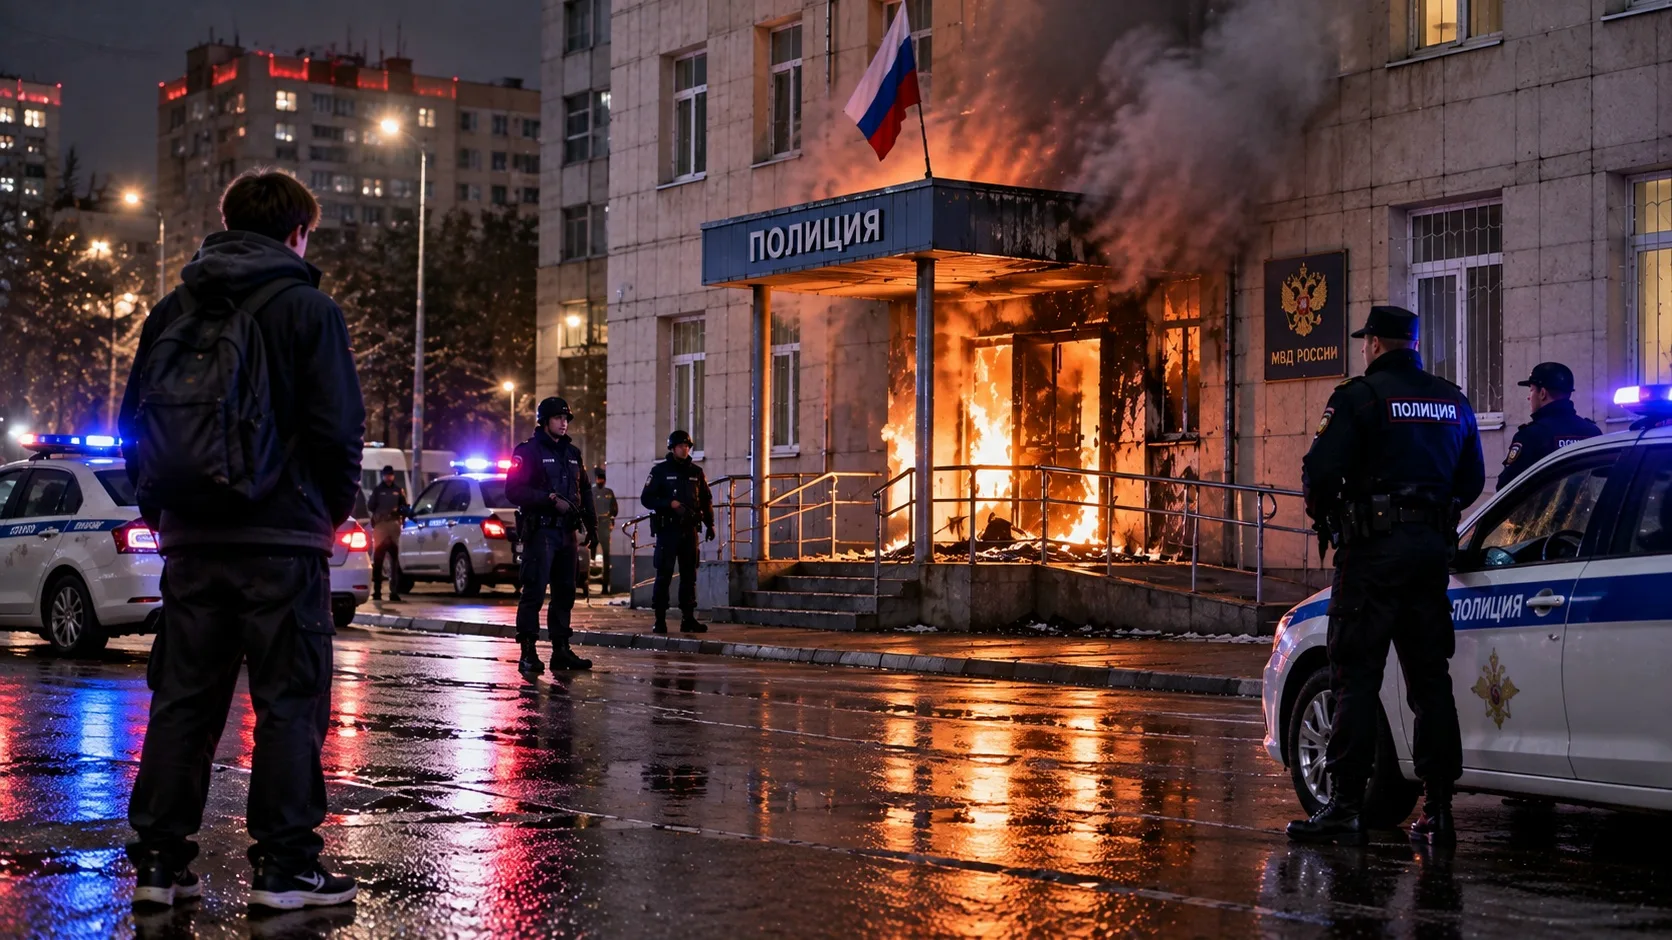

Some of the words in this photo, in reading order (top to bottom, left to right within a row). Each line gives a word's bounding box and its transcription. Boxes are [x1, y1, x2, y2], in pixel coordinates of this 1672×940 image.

[750, 208, 880, 262] ПОЛИЦИЯ
[1271, 349, 1294, 366] МВД
[1297, 345, 1338, 363] РОССИИ
[1391, 402, 1457, 421] ПОЛИЦИЯ
[1452, 594, 1524, 623] ПОЛИЦИЯ
